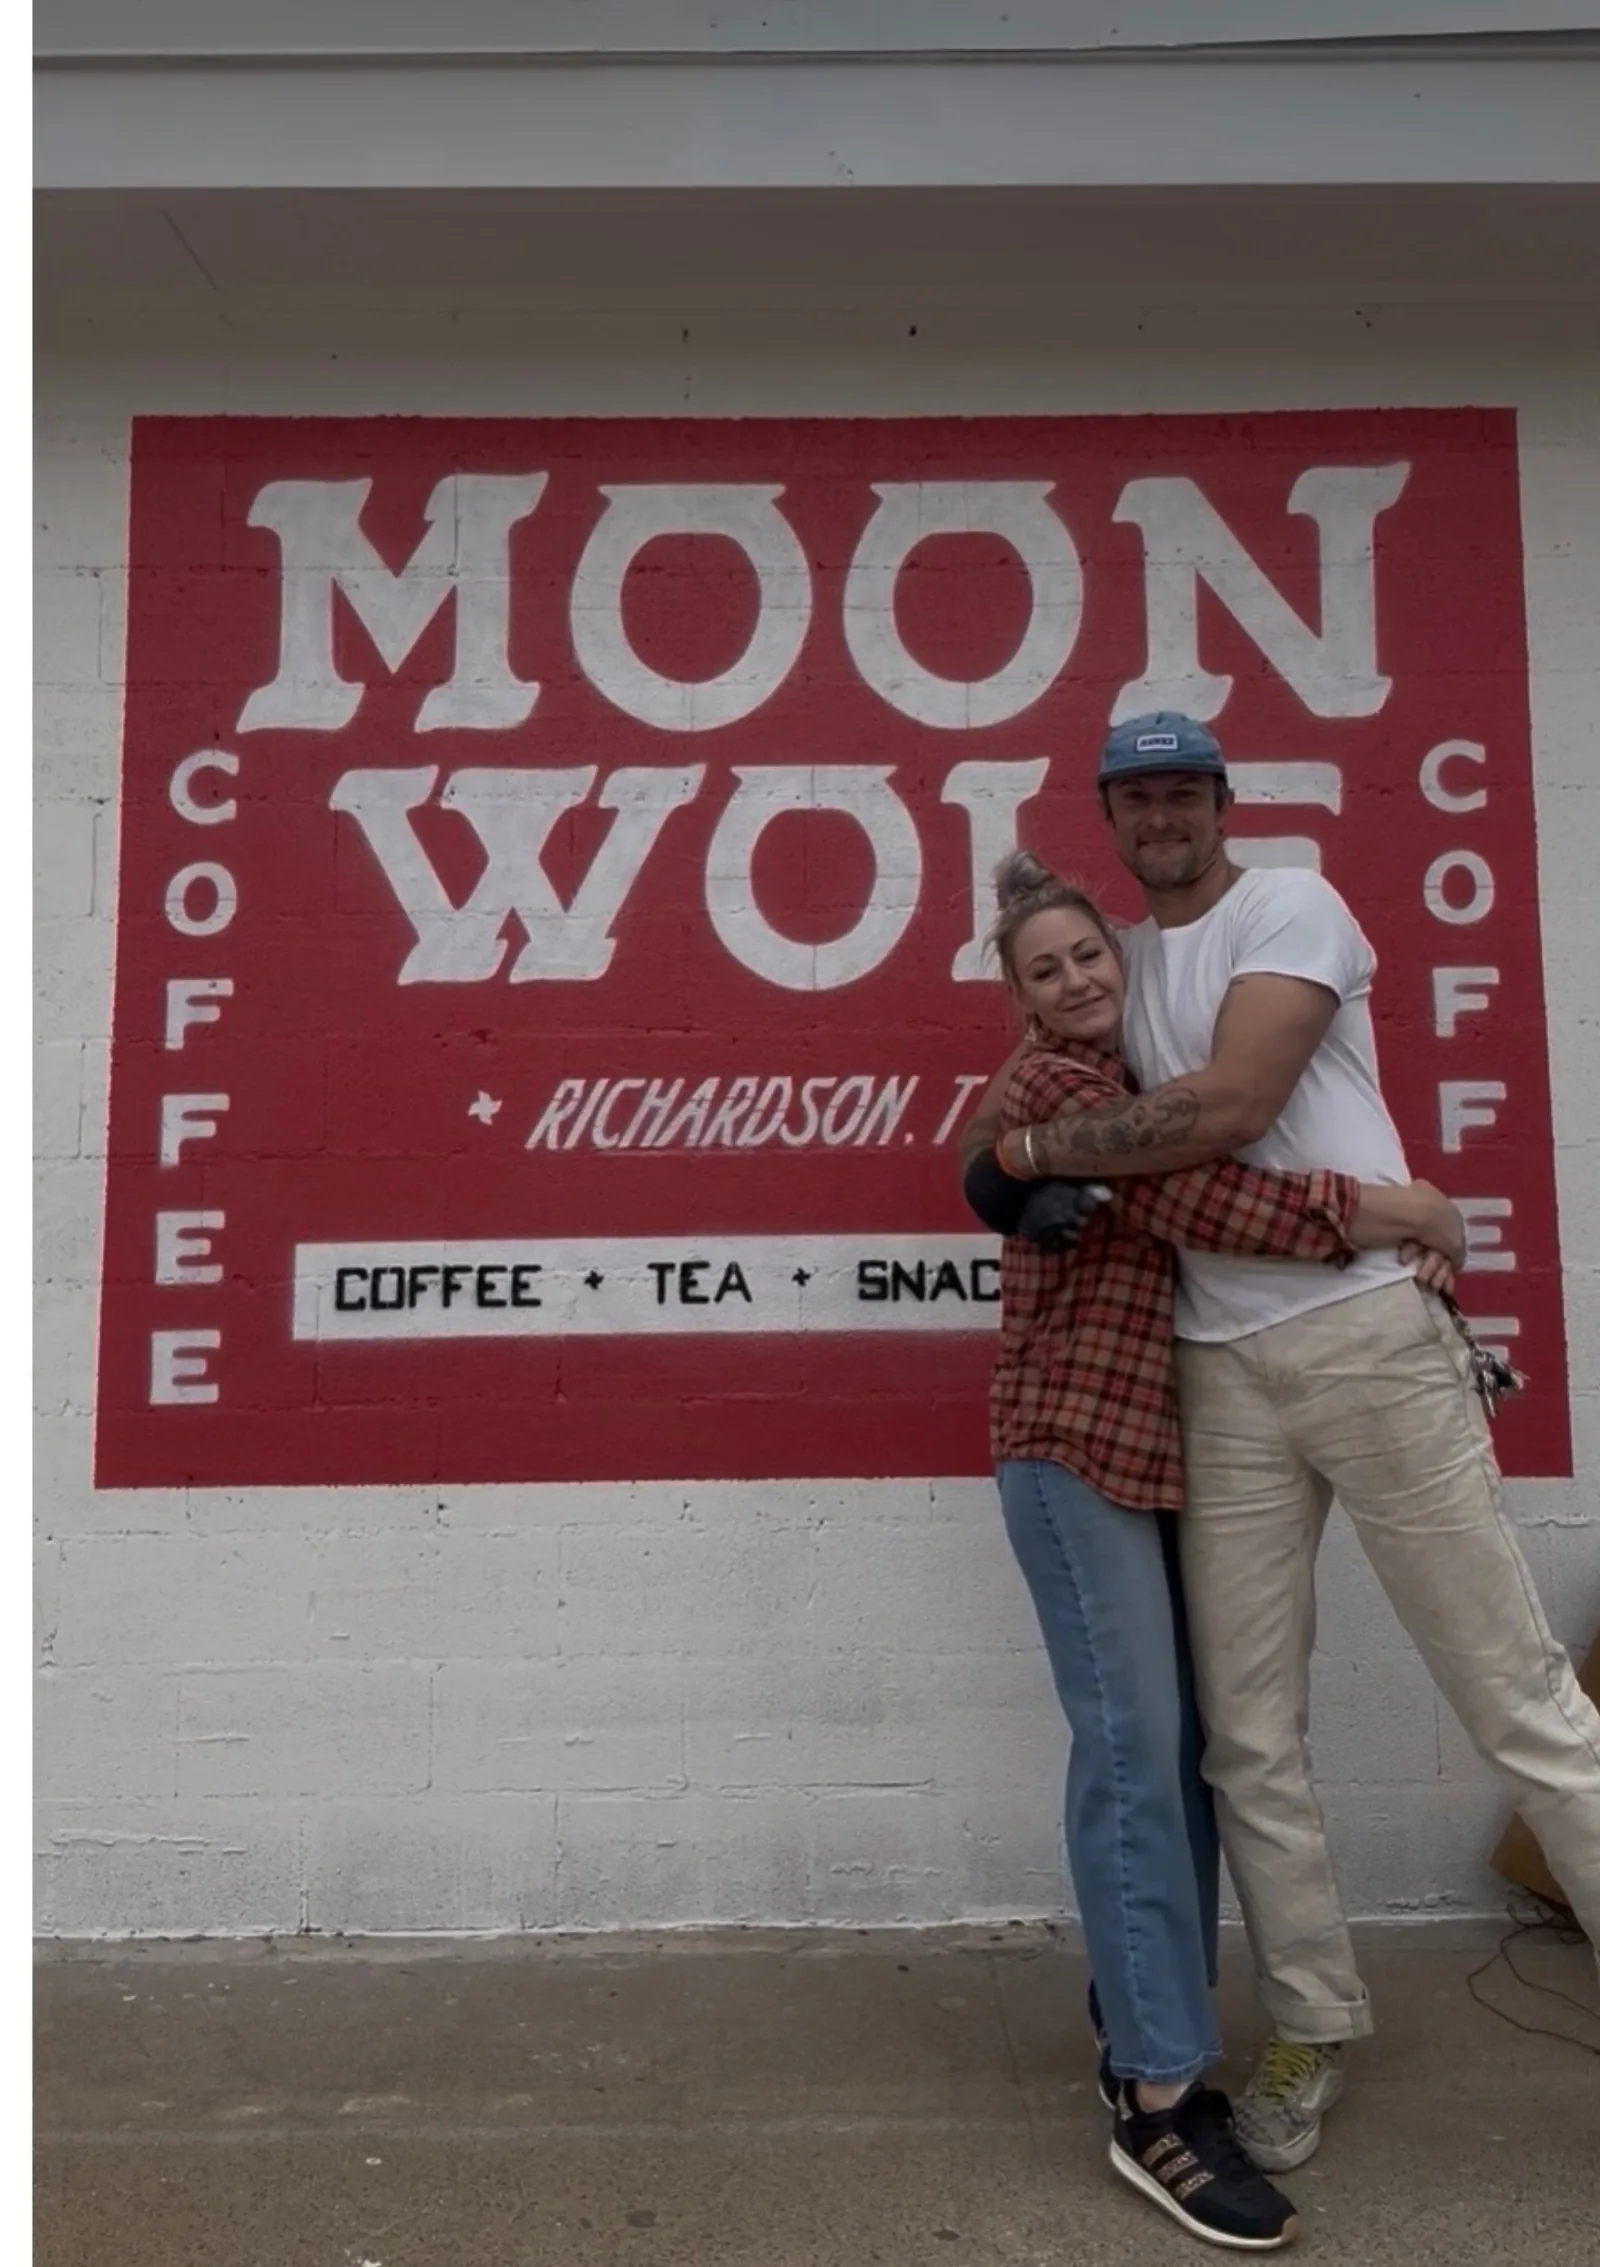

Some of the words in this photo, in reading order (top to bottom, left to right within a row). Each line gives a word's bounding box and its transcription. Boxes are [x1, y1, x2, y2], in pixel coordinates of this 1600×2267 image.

[235, 460, 1411, 735] MOON
[149, 748, 240, 1405] COFFEE
[932, 1073, 990, 1146] T
[334, 1263, 543, 1312] COFFEE
[646, 1260, 752, 1306] TEA
[857, 1258, 1002, 1301] SNAC
